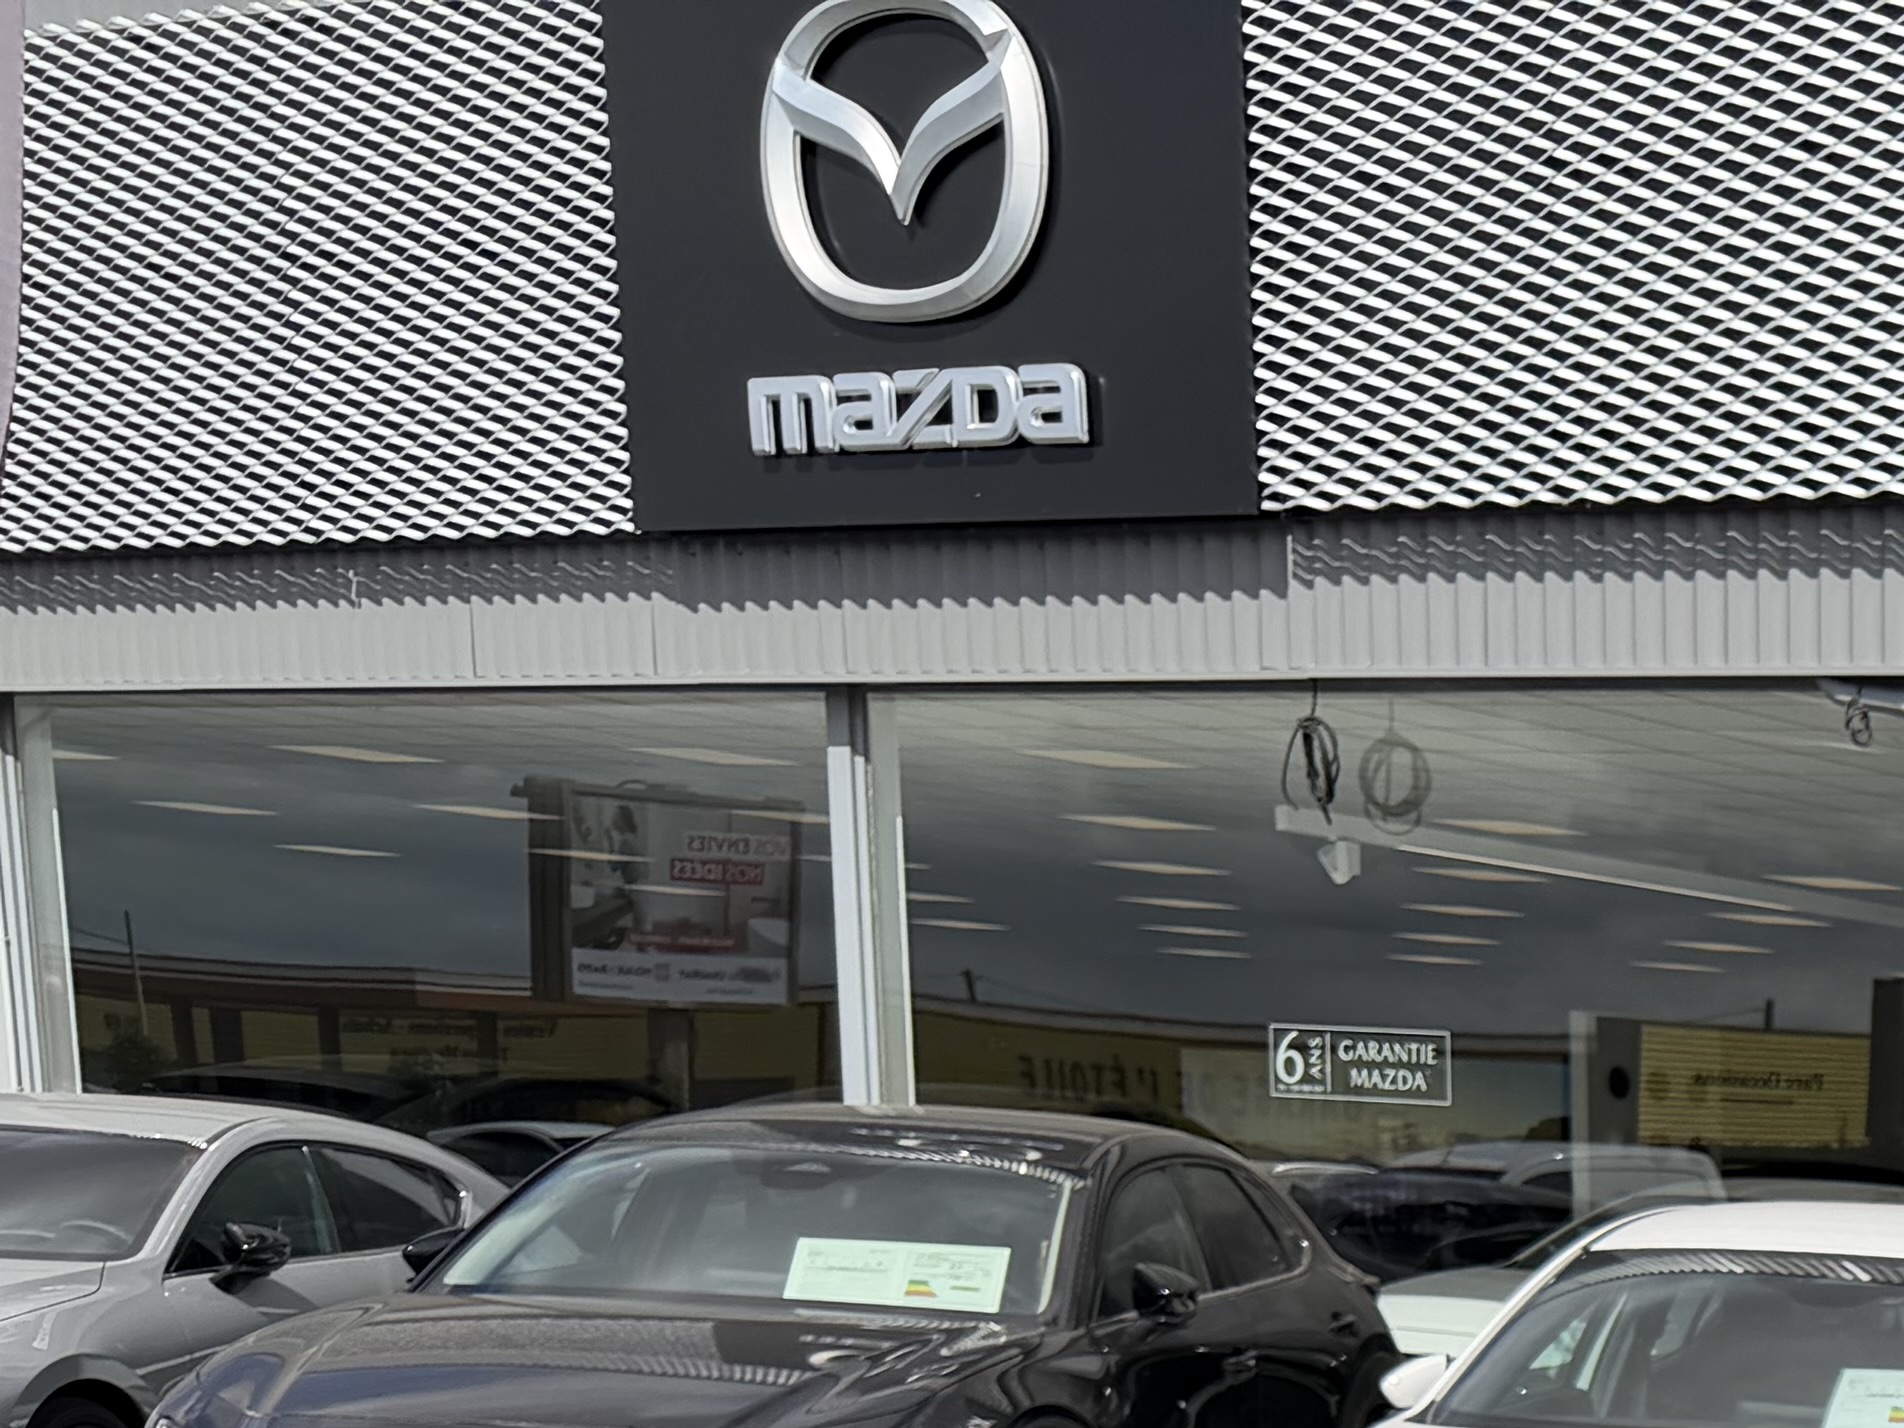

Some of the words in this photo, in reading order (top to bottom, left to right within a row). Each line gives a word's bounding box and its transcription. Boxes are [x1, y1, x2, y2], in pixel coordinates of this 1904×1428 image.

[1275, 1030, 1305, 1084] 6
[1337, 1038, 1439, 1066] GARANTIE
[1349, 1067, 1428, 1092] MAZDA
